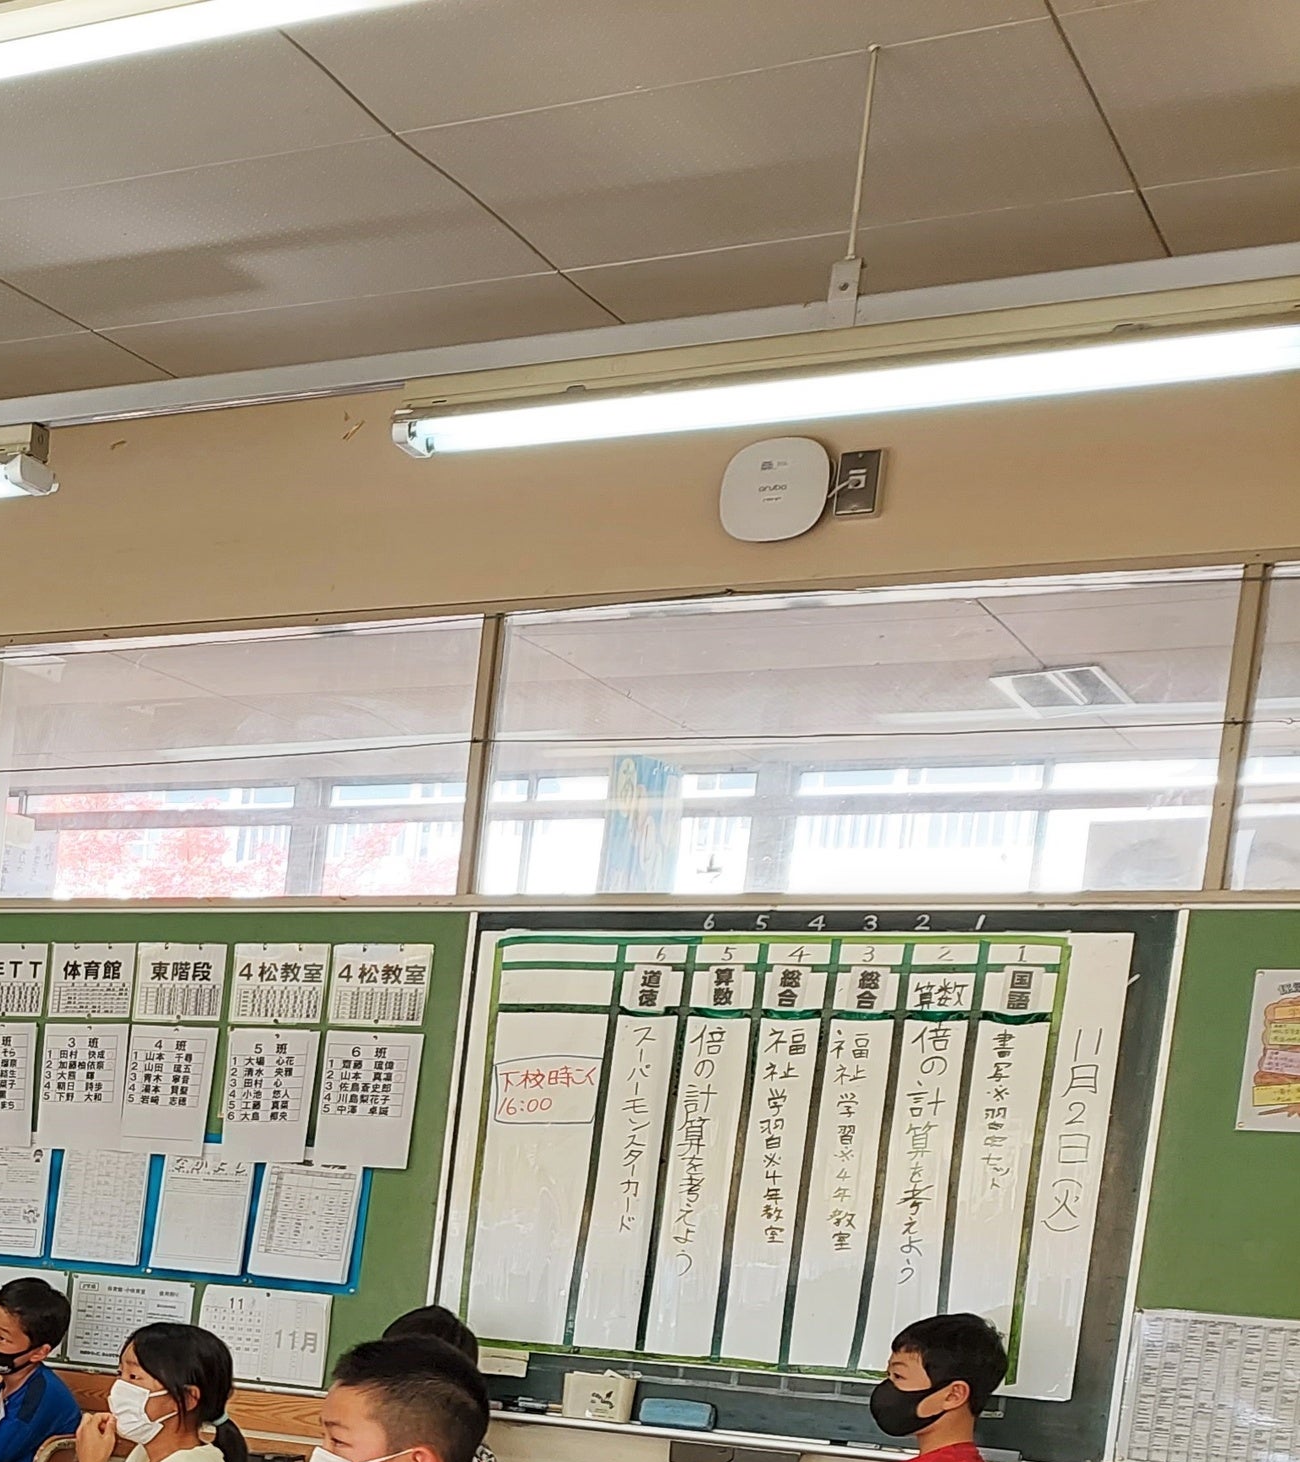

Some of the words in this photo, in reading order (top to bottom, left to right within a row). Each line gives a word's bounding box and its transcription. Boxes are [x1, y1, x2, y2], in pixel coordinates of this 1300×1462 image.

[704, 915, 715, 930] 6
[755, 915, 769, 930] 5
[808, 915, 826, 931] 4
[863, 916, 878, 931] 3
[914, 915, 931, 930] 2
[975, 914, 987, 930] 1
[656, 947, 666, 962] 6
[721, 946, 734, 961] 5
[788, 946, 810, 961] 4
[862, 946, 875, 962] 3
[938, 946, 954, 962] 2
[1018, 946, 1028, 962] 1
[63, 960, 122, 980] 体育館
[151, 962, 212, 981] 東階段
[239, 962, 323, 983] 4松教室
[338, 964, 426, 984] 4松教室
[638, 970, 662, 1007] 道徳
[713, 968, 734, 1005] 算数
[777, 969, 801, 1007] 総合
[856, 970, 879, 1009] 総合
[913, 978, 969, 1008] 算数
[1007, 971, 1034, 1009] 国語
[2, 1036, 12, 1046] 班
[68, 1038, 75, 1047] 3
[88, 1038, 99, 1048] 班
[155, 1040, 163, 1050] 4
[176, 1041, 187, 1051] 班
[60, 1050, 77, 1059] 田村
[146, 1052, 164, 1061] 山本
[255, 1044, 262, 1053] 5
[276, 1044, 287, 1054] 班
[352, 1047, 361, 1057] 6
[374, 1048, 387, 1058] 班
[144, 1063, 163, 1071] 山田
[276, 1057, 294, 1065] 心花
[144, 1074, 162, 1082] 青木
[244, 1068, 264, 1077] 清水
[341, 1072, 362, 1080] 山本
[499, 1066, 598, 1088] 下校時こく
[244, 1079, 262, 1088] 田村
[56, 1093, 74, 1101] 下野
[85, 1093, 102, 1101] 大和
[243, 1091, 262, 1099] 小池
[497, 1097, 553, 1116] 16:00
[619, 1026, 657, 1233] スーパーモンスターカード
[673, 1024, 726, 1276] 倍の計算を考えよう
[897, 1022, 952, 1284] 倍の計算を考えよう
[230, 1298, 244, 1309] 11
[275, 1329, 317, 1353] 11月
